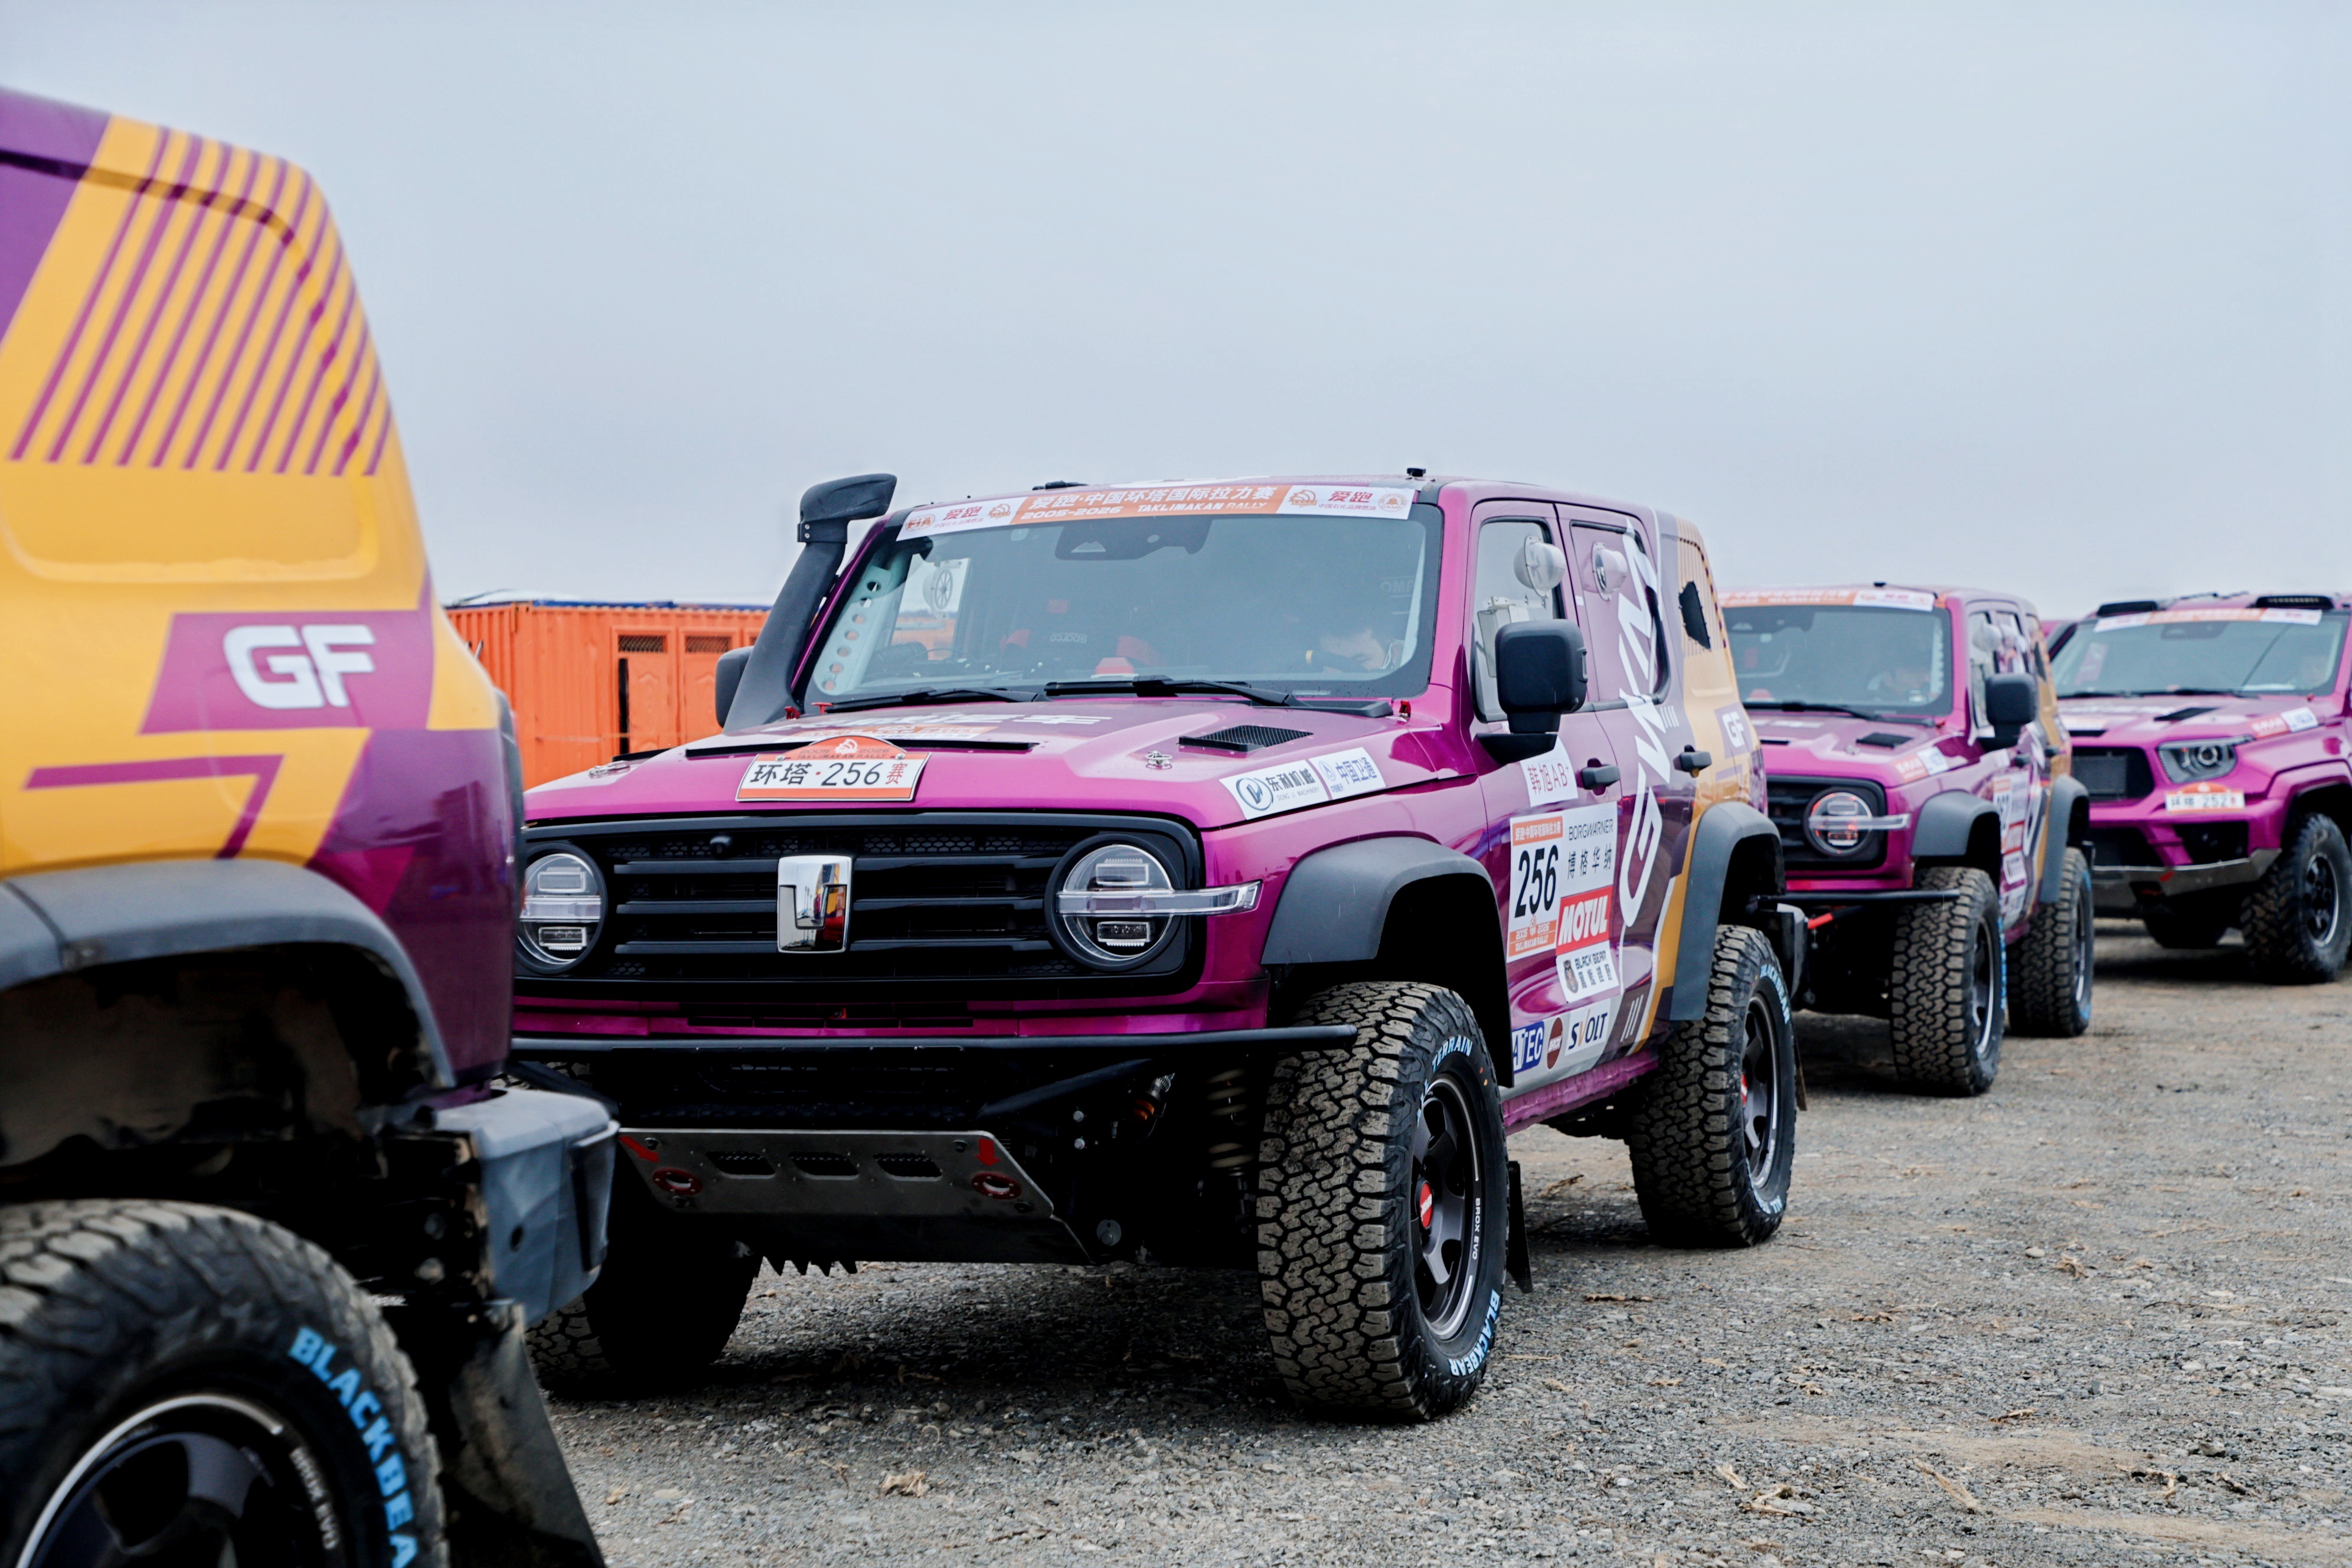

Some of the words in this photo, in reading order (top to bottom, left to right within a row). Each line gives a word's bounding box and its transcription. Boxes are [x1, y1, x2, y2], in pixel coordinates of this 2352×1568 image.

[1028, 486, 1277, 509] 爱跑·中国环塔国际拉力赛
[1138, 503, 1224, 512] TAKLIMAKAN
[1328, 491, 1373, 502] 爱跑
[943, 506, 982, 520] 爱跑
[1021, 506, 1123, 520] 2005-2026
[223, 624, 376, 709] GF
[1722, 711, 1744, 747] GF
[1266, 768, 1316, 791] 东利机械
[1335, 757, 1378, 785] 中国卫通
[1276, 793, 1291, 801] DONG
[1297, 786, 1320, 796] MACHINERY
[1569, 819, 1613, 841] BORGWARNER
[1567, 844, 1612, 880] 博格华纳
[1515, 845, 1559, 918] 256
[1558, 895, 1608, 946] MOTUL
[1574, 954, 1594, 970] BLACK
[1592, 950, 1607, 965] BEAR
[1568, 1009, 1608, 1050] SVOLT
[1432, 1034, 1473, 1072] TERRAIN
[1448, 1289, 1501, 1377] BLACKBEAR
